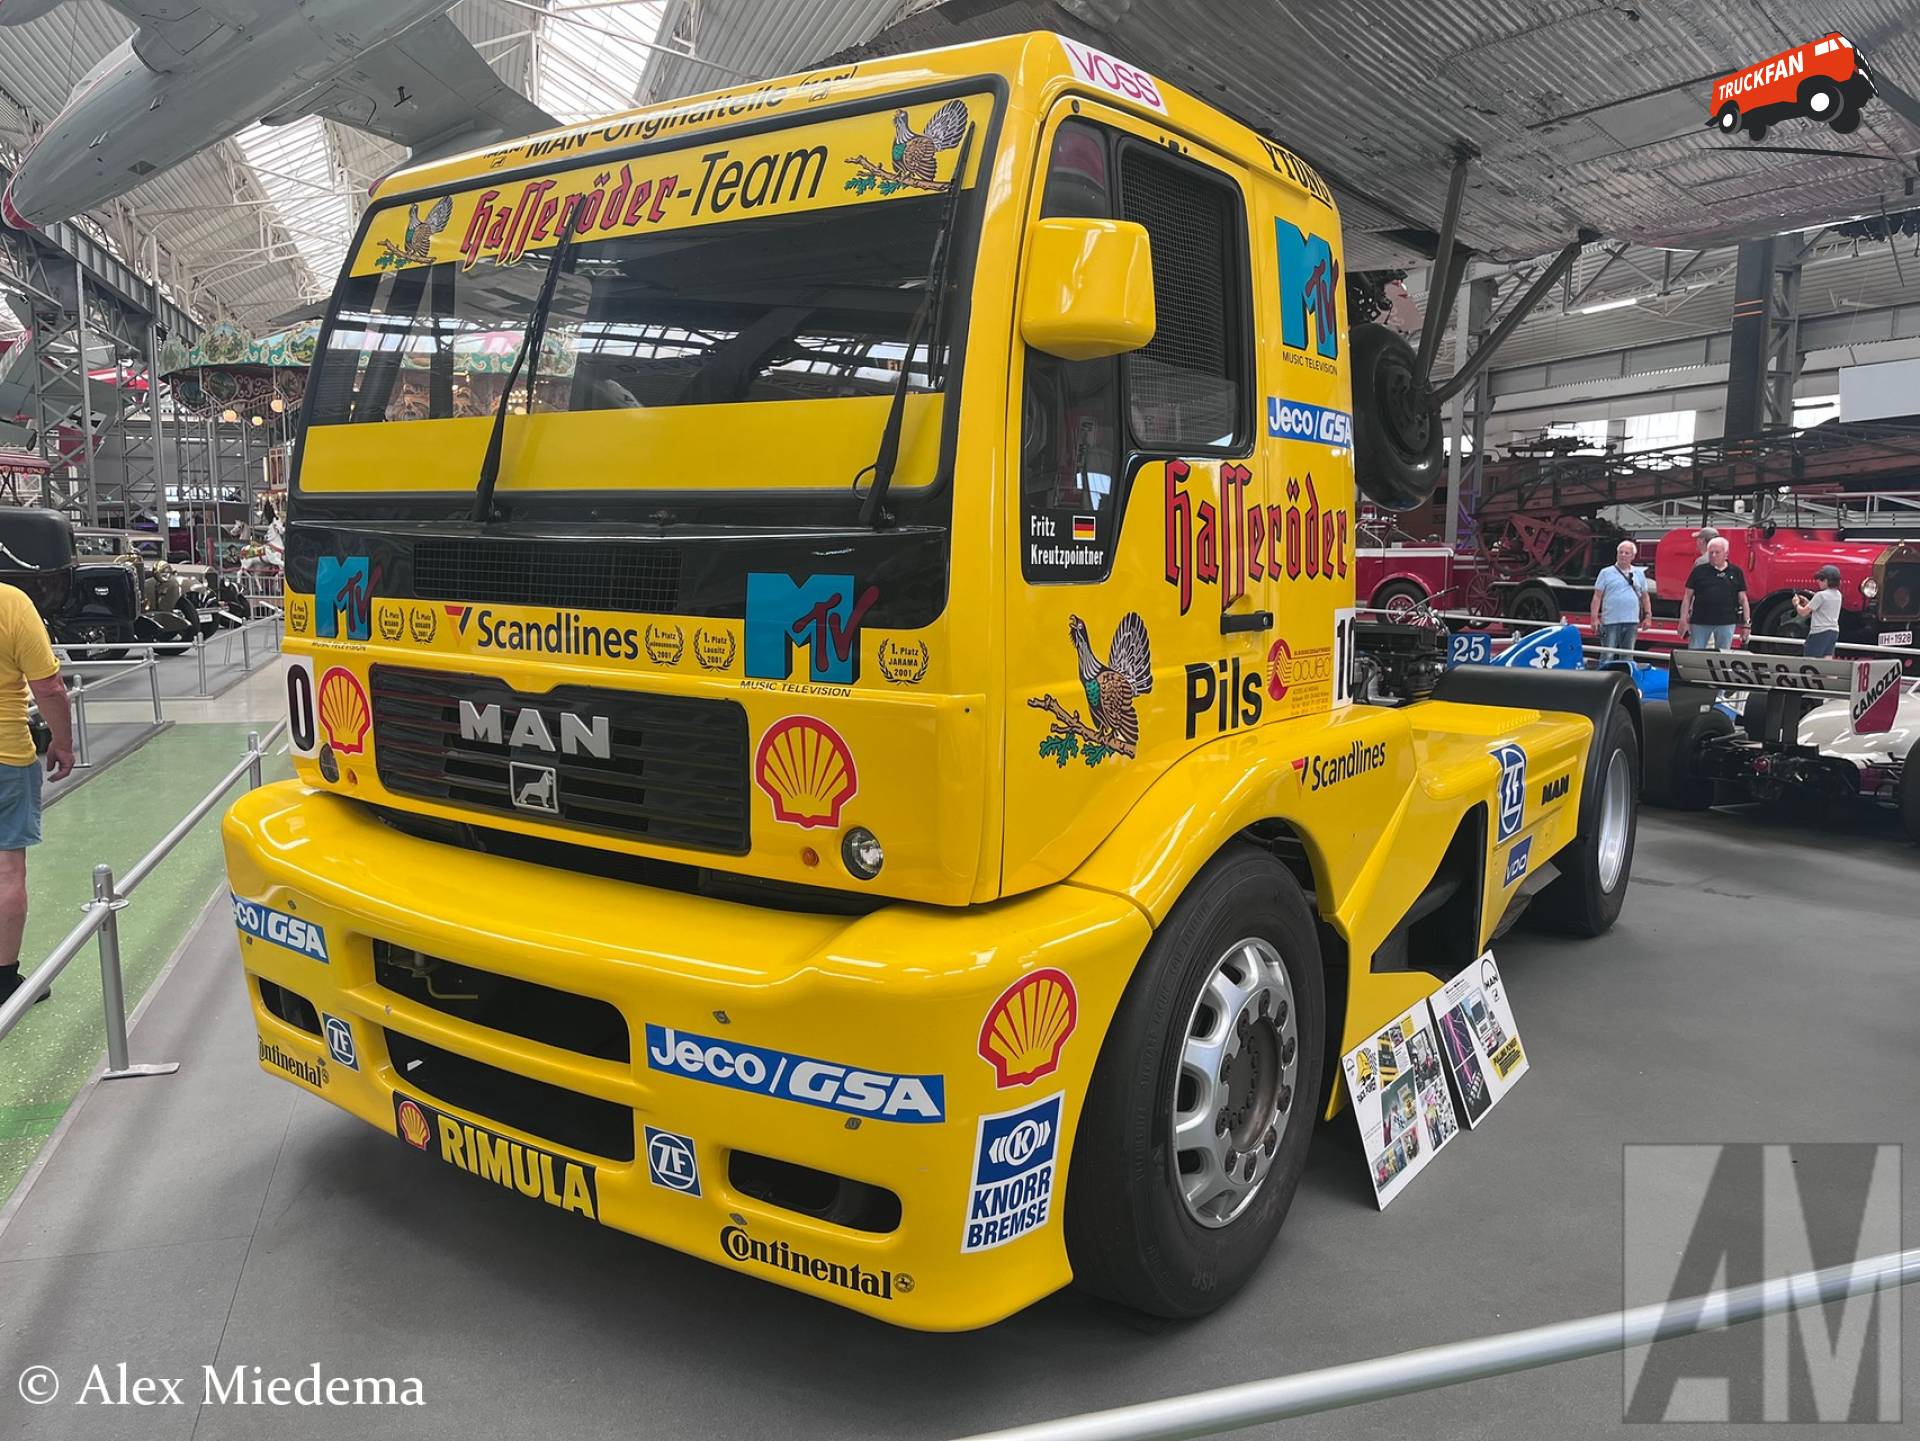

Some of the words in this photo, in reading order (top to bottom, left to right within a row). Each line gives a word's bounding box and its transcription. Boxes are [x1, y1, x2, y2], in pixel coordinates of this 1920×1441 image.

[1065, 42, 1161, 108] VOSS
[1274, 215, 1340, 361] MTV
[1282, 350, 1304, 367] MUSIC
[1304, 358, 1338, 376] TELEVISION
[1031, 514, 1056, 537] Fritz
[1031, 543, 1104, 569] Kreutzpointner
[315, 555, 384, 642] MTV
[477, 610, 639, 660] Scandlines
[661, 631, 676, 640] Platz
[711, 635, 727, 645] Platz
[744, 572, 880, 685] MTV
[891, 643, 898, 655] 1.
[900, 647, 919, 656] Platz
[1452, 636, 1486, 662] 25
[888, 658, 918, 667] JARAMA
[894, 668, 912, 678] 2001
[1856, 662, 1871, 693] 18
[740, 680, 777, 691] MUSIC
[781, 683, 852, 698] TELEVISION
[1185, 657, 1263, 740] Pils
[1852, 662, 1901, 720] CAMOZZI
[458, 699, 611, 759] MAN
[1311, 739, 1387, 792] Scandlines
[437, 1114, 596, 1220] RIMULA
[971, 1164, 1052, 1220] KNORR
[966, 1198, 1048, 1249] BREMSE
[719, 1225, 893, 1300] Continental
